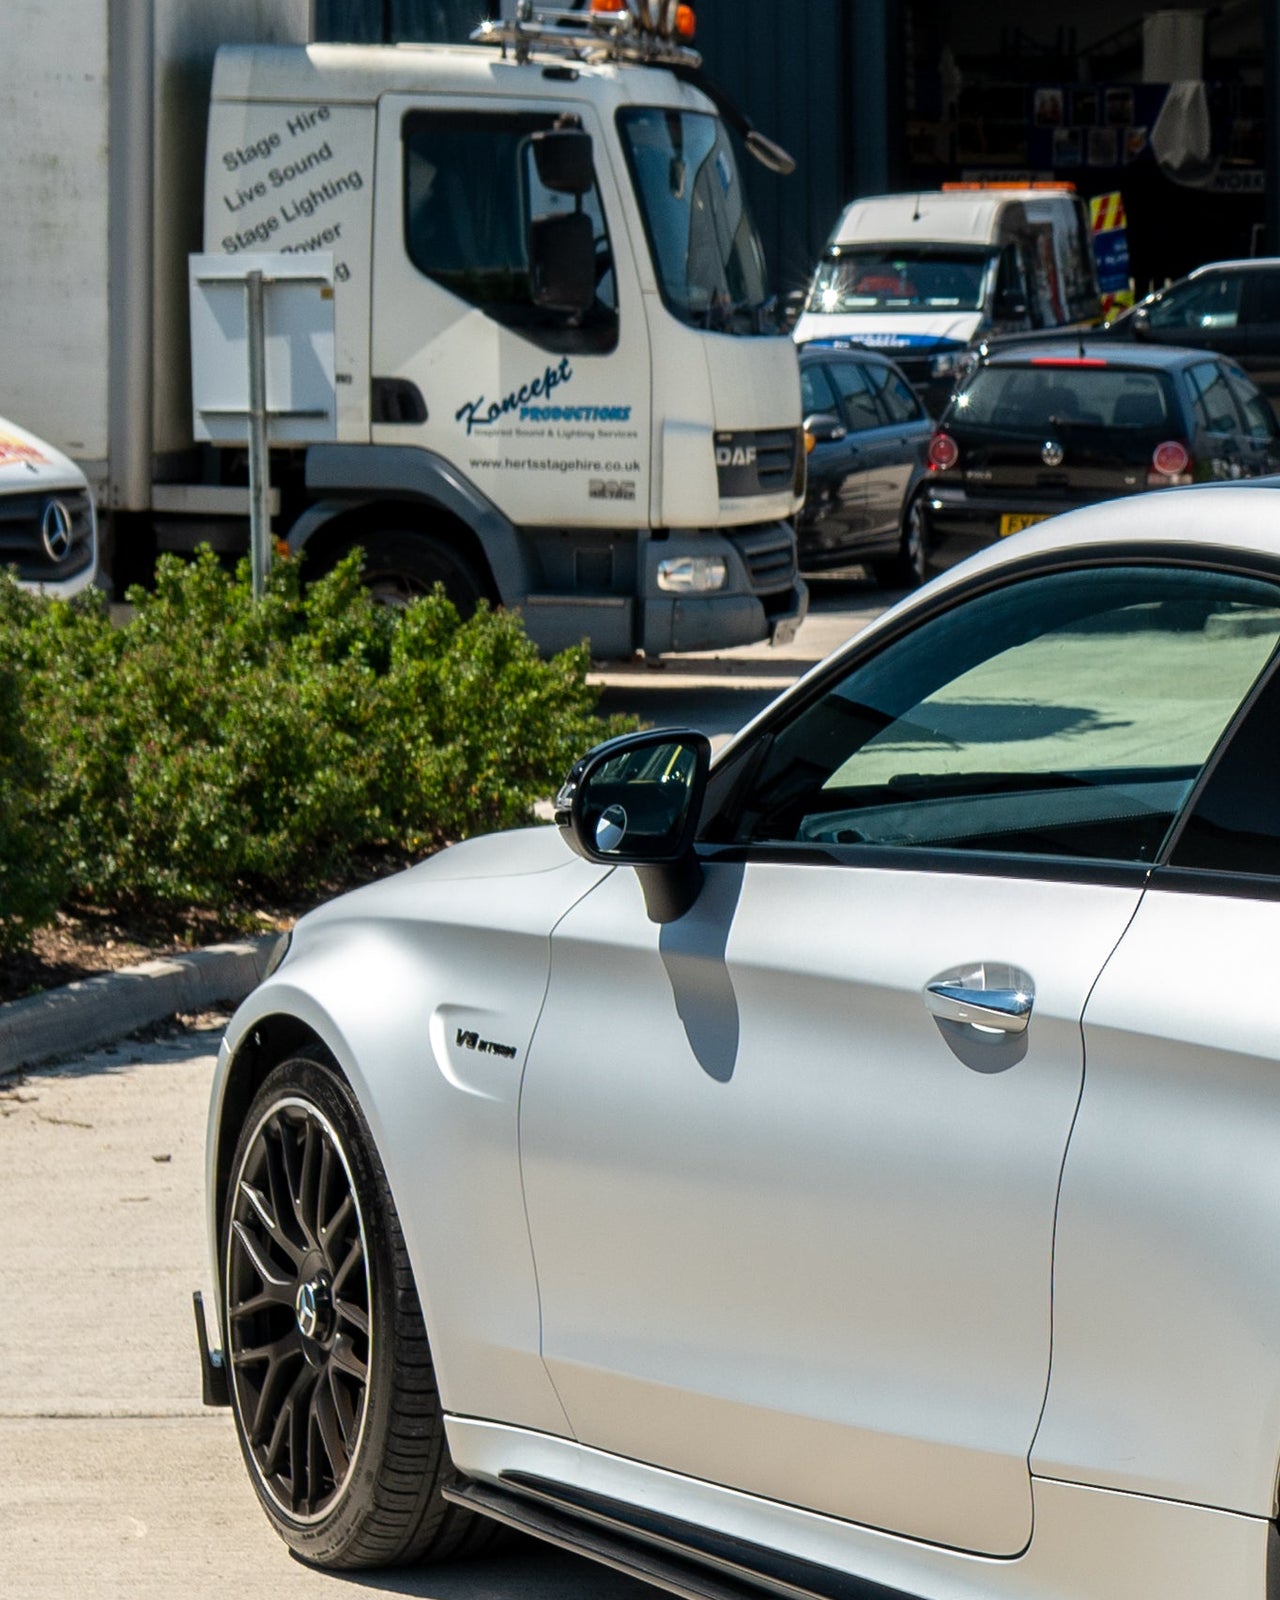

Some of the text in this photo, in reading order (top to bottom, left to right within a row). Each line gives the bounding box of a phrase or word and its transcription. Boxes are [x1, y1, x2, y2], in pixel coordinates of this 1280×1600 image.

[222, 105, 330, 172] Stage Hire
[223, 141, 333, 214] Live Sound
[221, 170, 363, 254] Stage Lighting
[455, 356, 573, 436] Koncept
[519, 405, 632, 421] PRODUCTIONS
[469, 457, 641, 473] www.hertsstagehire.co.uk
[715, 445, 757, 466] DAF
[456, 1028, 479, 1050] V8
